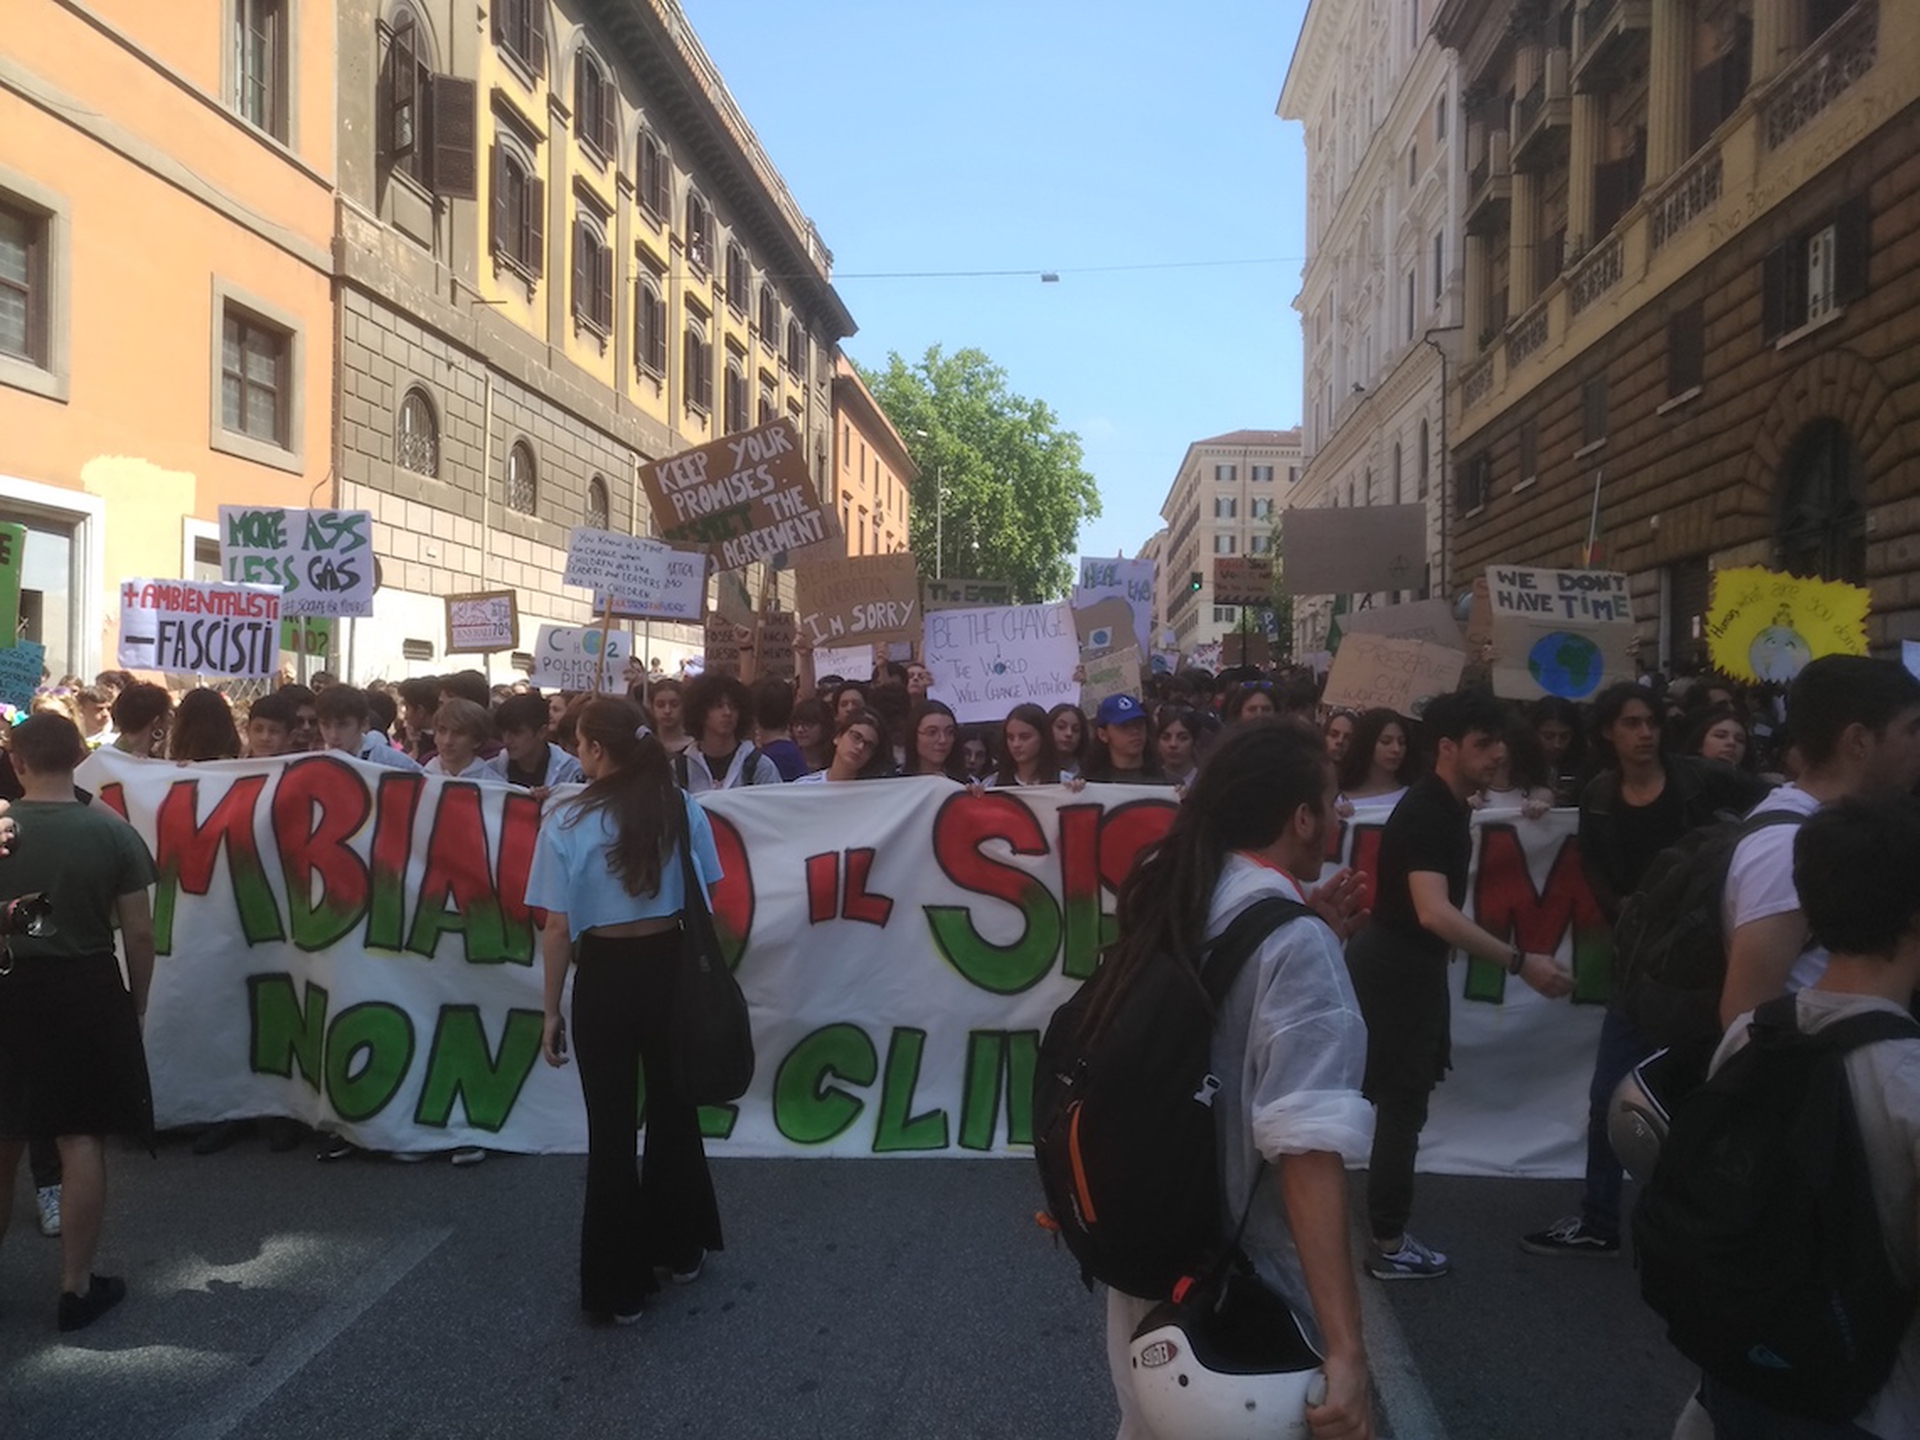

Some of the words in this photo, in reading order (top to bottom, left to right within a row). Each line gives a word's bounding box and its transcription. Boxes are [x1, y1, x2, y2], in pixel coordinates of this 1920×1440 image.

[655, 451, 708, 494] KEEP
[727, 426, 793, 470] YOUR
[763, 485, 809, 521] THE
[227, 510, 286, 549] MORE
[301, 511, 366, 554] ASS
[722, 509, 825, 568] AGREEMENT
[229, 555, 300, 592] LESS
[307, 555, 360, 593] GAS
[621, 571, 660, 590] LEADERS
[1497, 571, 1537, 589] WE
[1557, 573, 1625, 592] DON'T
[850, 599, 915, 632] SORRY
[1497, 591, 1554, 612] HAVE
[933, 616, 958, 649] BE
[963, 612, 998, 645] THE
[1001, 606, 1067, 641] CHANGE
[806, 849, 893, 928] IL
[247, 972, 544, 1133] NON
[773, 1022, 1037, 1152] CLI
